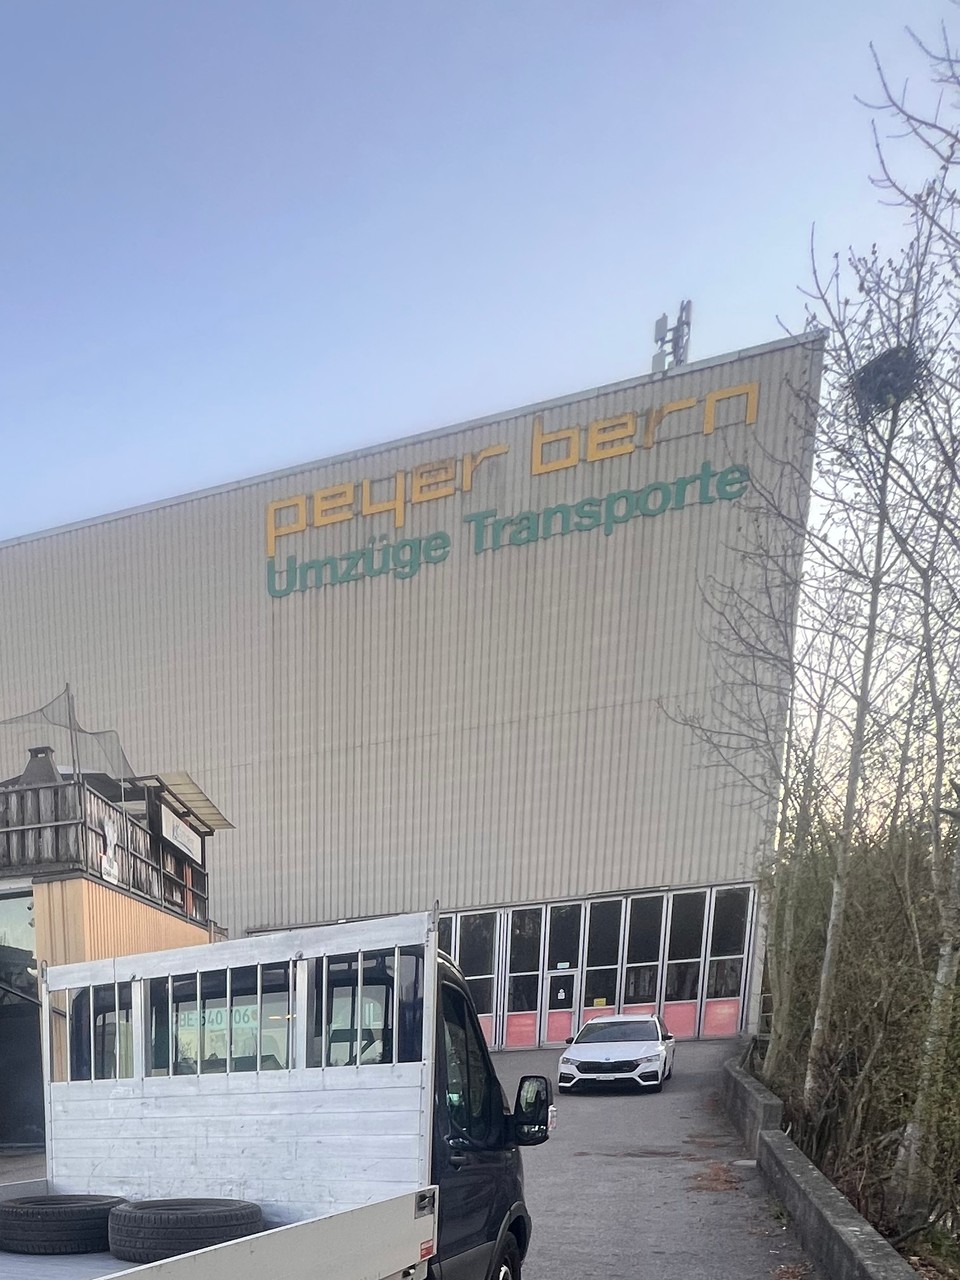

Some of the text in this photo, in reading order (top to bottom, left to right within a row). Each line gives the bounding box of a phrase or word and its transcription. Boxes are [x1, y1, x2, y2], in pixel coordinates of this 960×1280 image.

[267, 381, 761, 558] peyer bern
[267, 460, 750, 598] Umzüge Transporte
